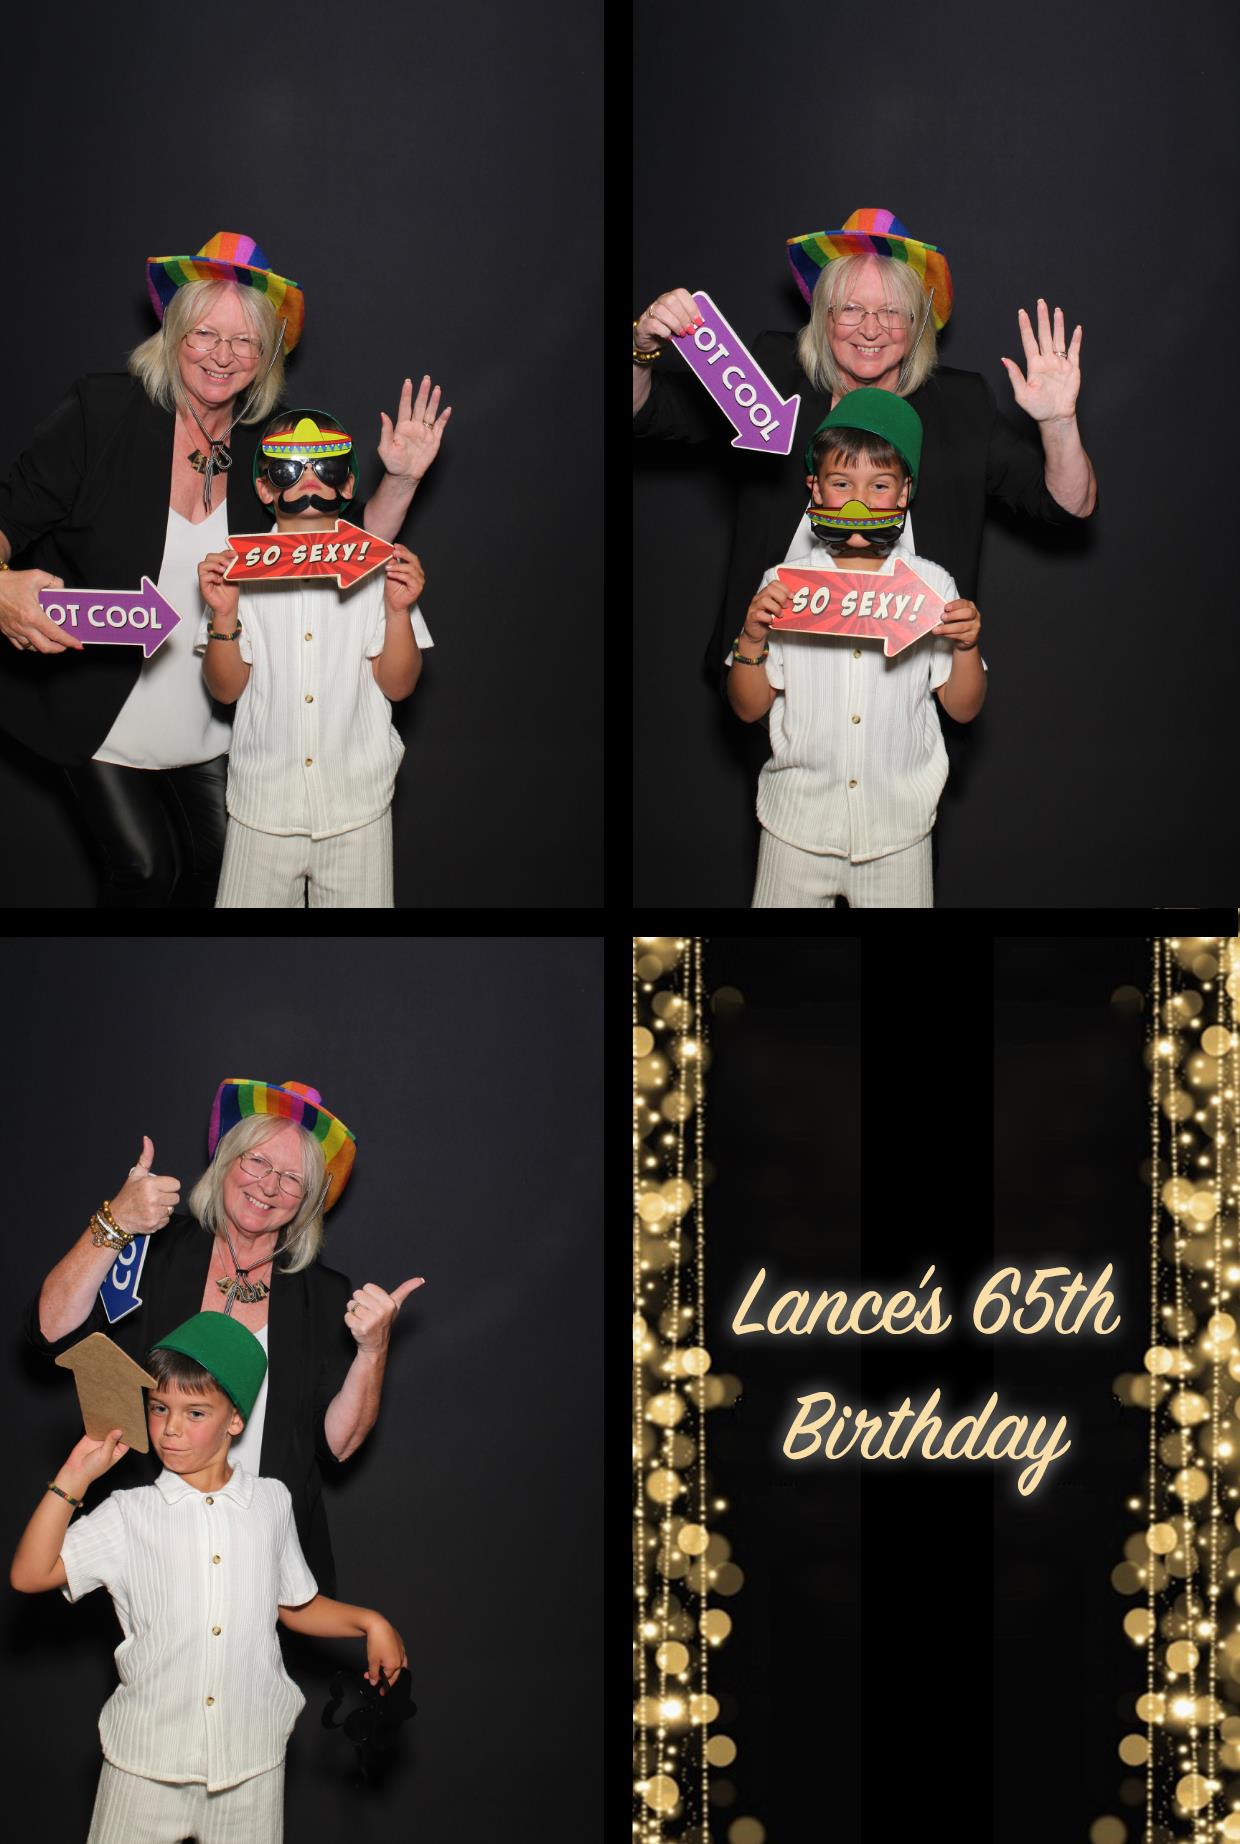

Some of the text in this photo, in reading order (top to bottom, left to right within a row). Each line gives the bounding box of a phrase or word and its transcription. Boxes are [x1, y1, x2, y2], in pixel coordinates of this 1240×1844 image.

[693, 318, 780, 442] OT COOL
[245, 541, 370, 567] SO SEXY!
[40, 603, 163, 630] OT COOL
[792, 586, 926, 622] SO SEXY!
[112, 1240, 137, 1291] CO
